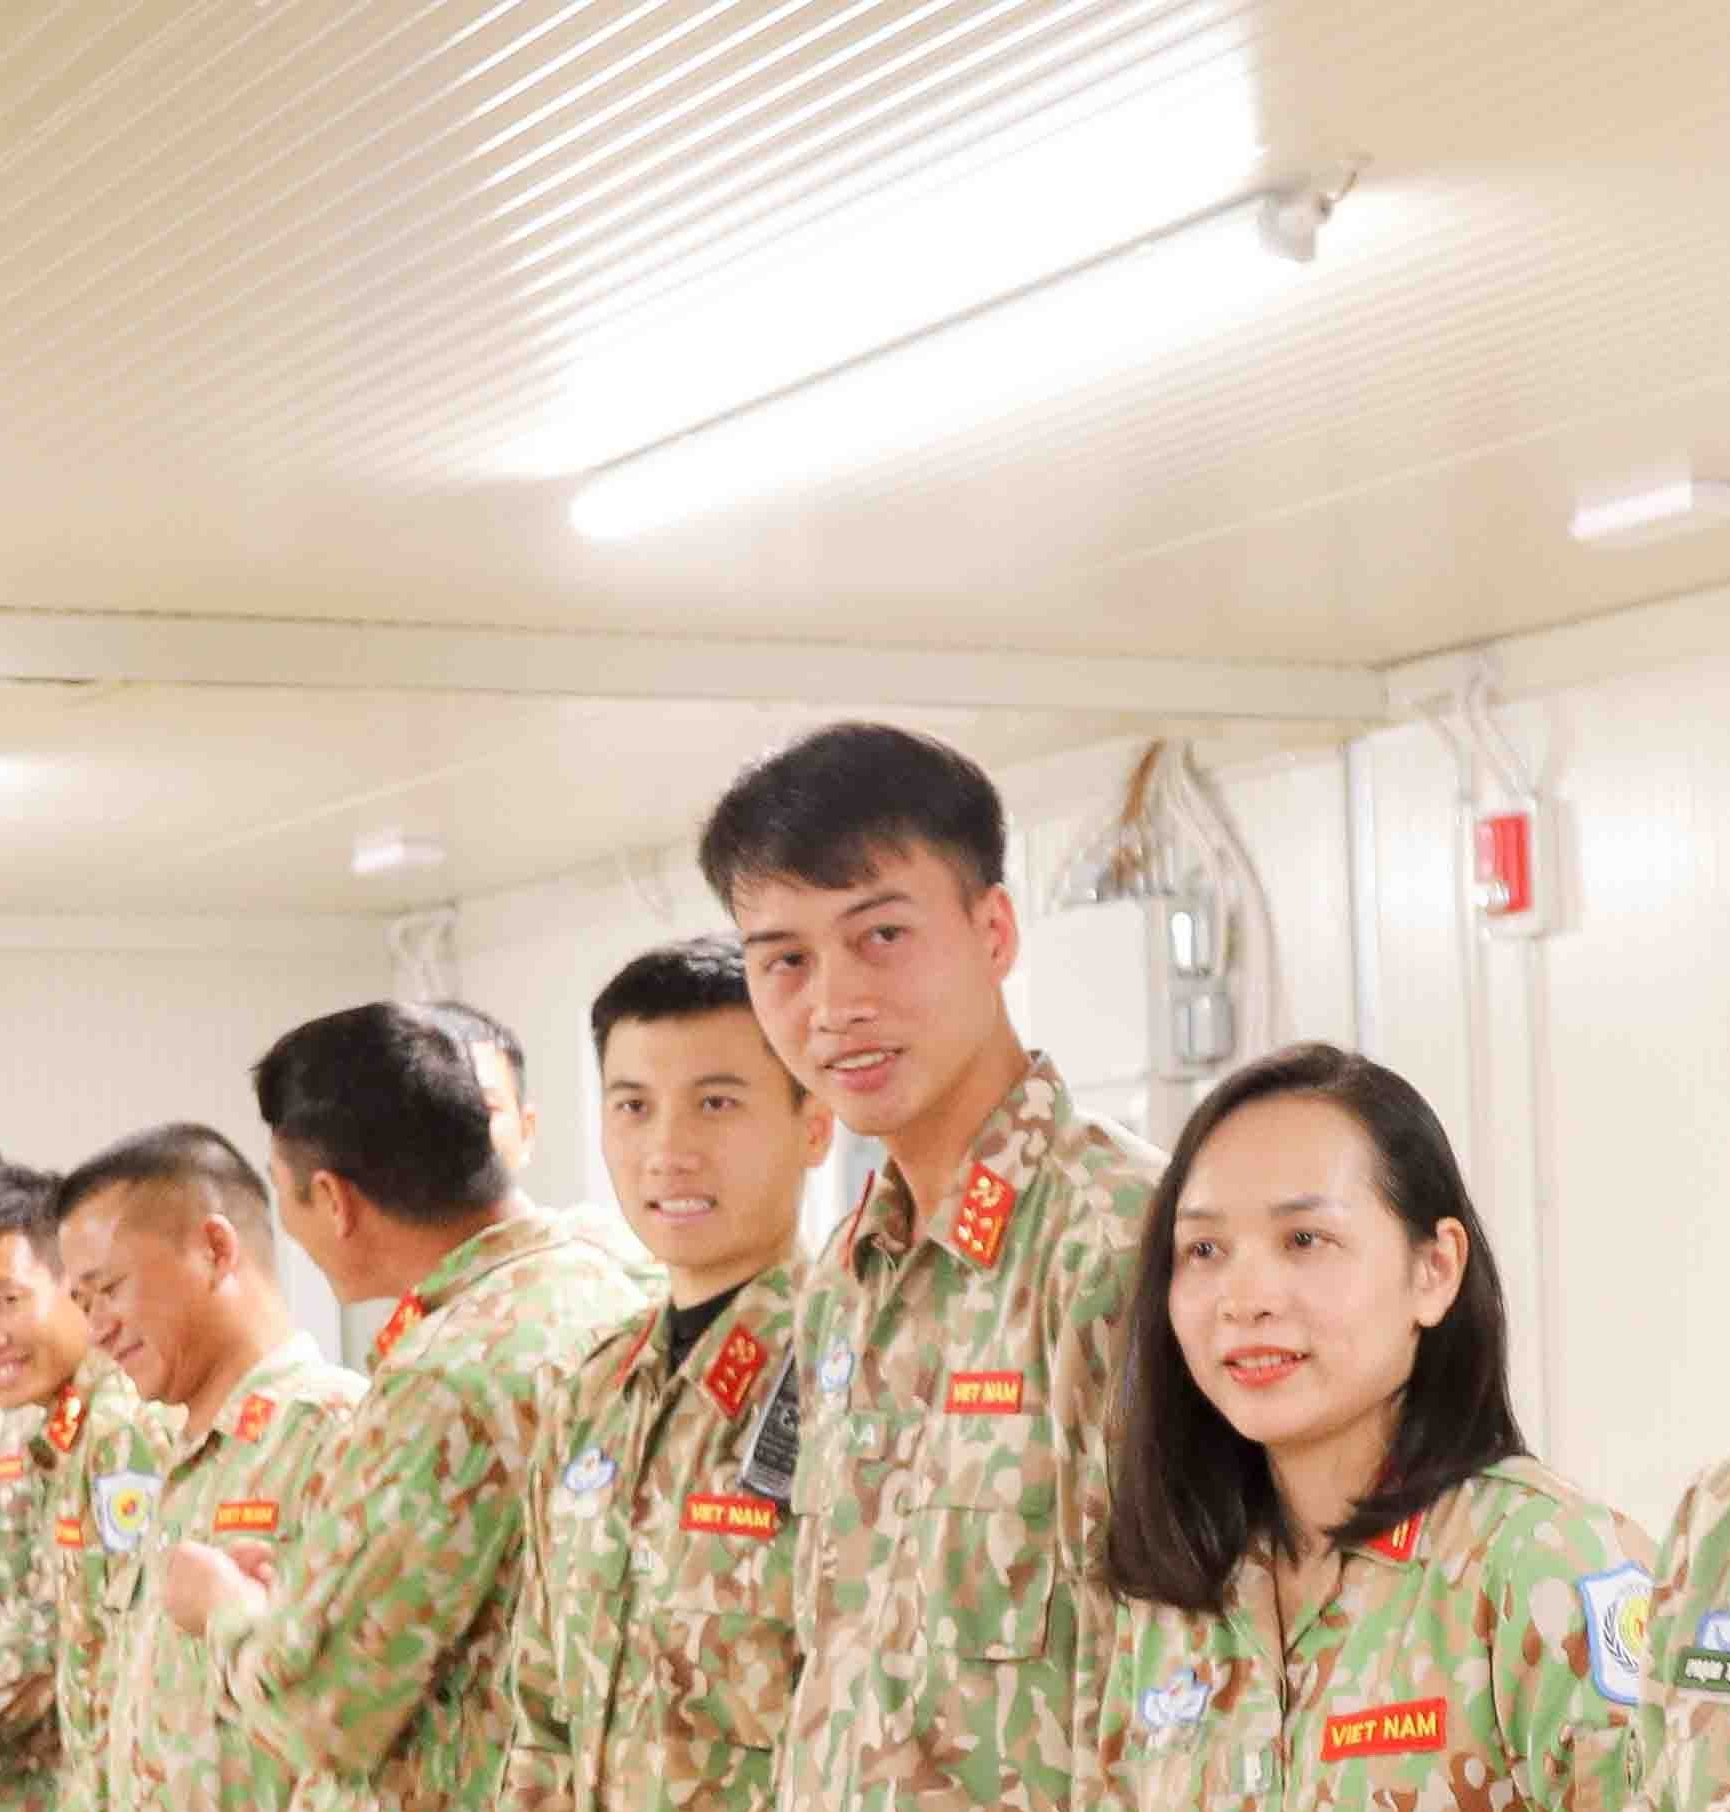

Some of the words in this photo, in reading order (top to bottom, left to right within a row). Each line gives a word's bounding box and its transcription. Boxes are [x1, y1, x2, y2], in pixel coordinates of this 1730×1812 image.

[728, 1504, 770, 1528] NAM
[1332, 1719, 1377, 1746] VIET
[1382, 1711, 1438, 1740] NAM
